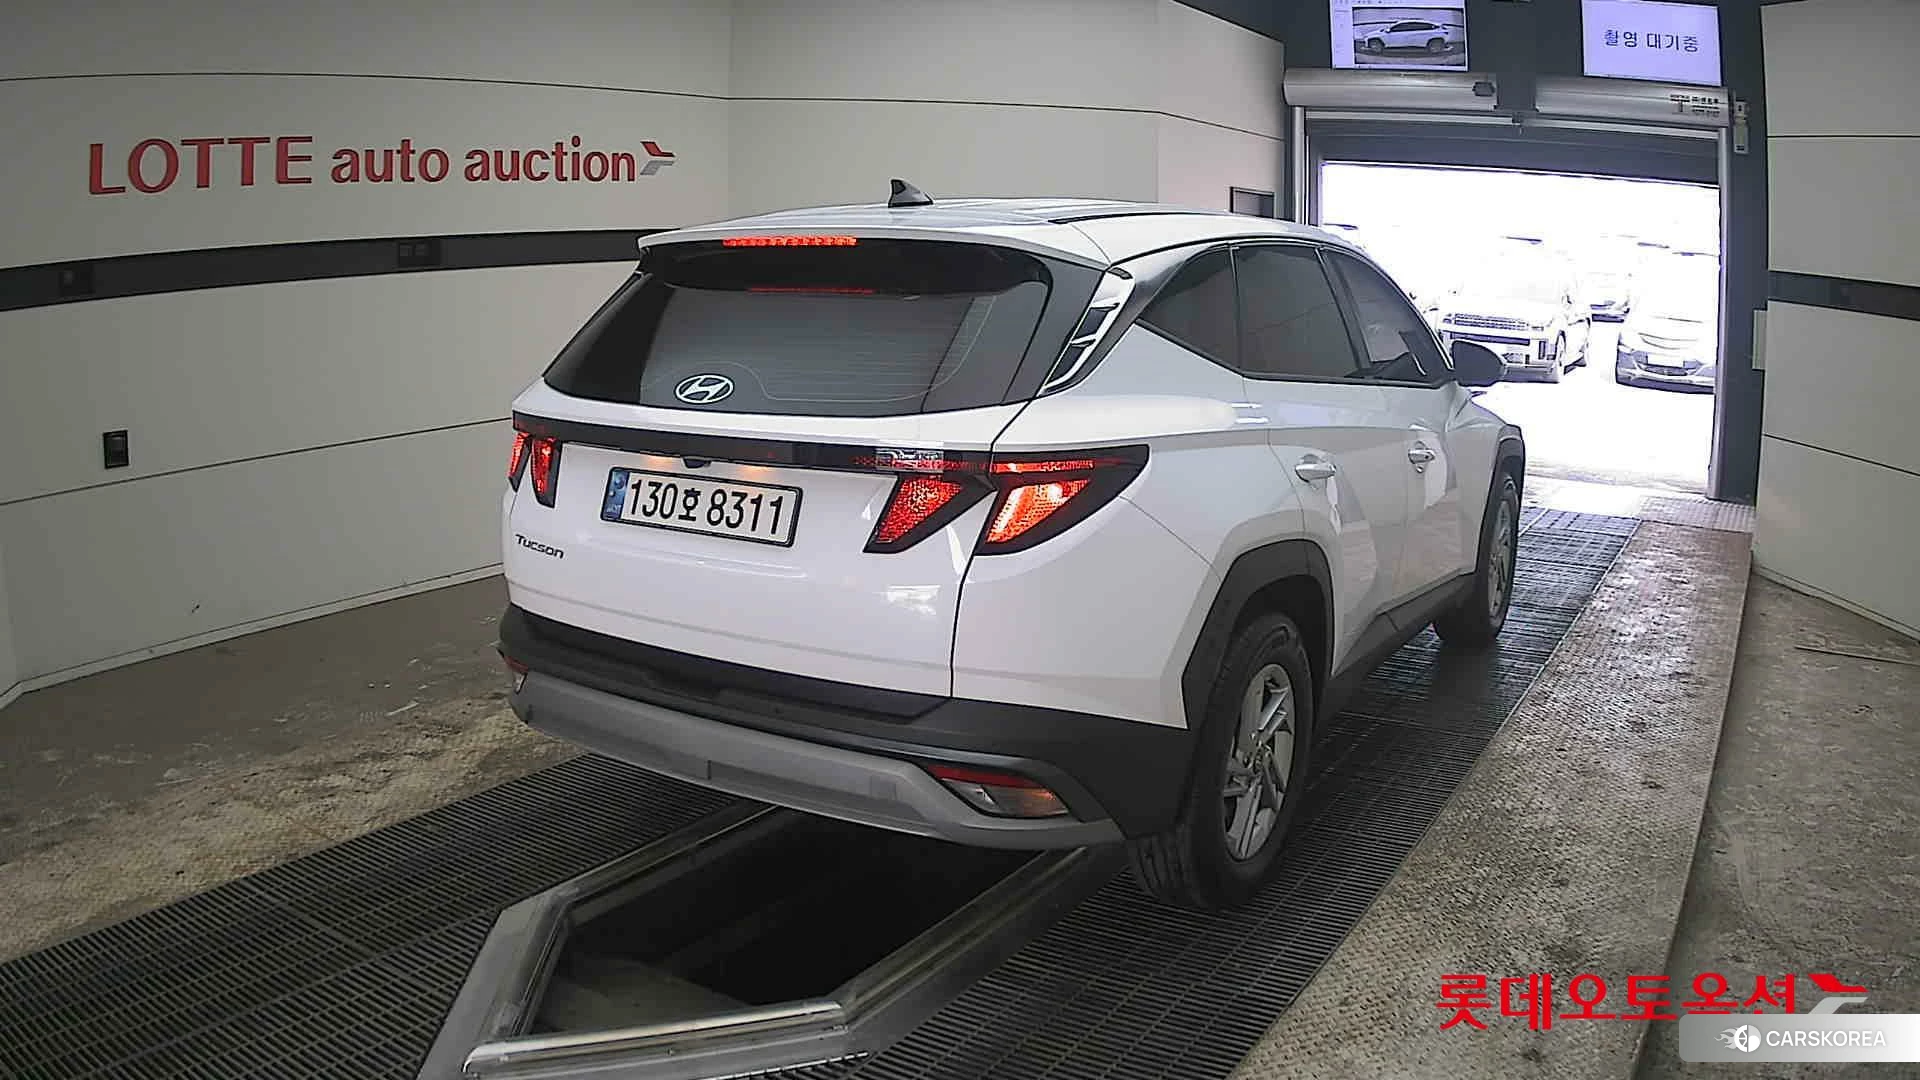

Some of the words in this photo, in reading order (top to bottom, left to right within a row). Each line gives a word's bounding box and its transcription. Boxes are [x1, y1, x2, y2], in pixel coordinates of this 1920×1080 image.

[1646, 33, 1699, 52] 대기중
[89, 136, 312, 194] LOTTE
[331, 138, 450, 183] auto
[463, 135, 635, 182] auction
[631, 479, 700, 521] 130호
[706, 489, 784, 535] 8311
[515, 533, 564, 559] Tucson
